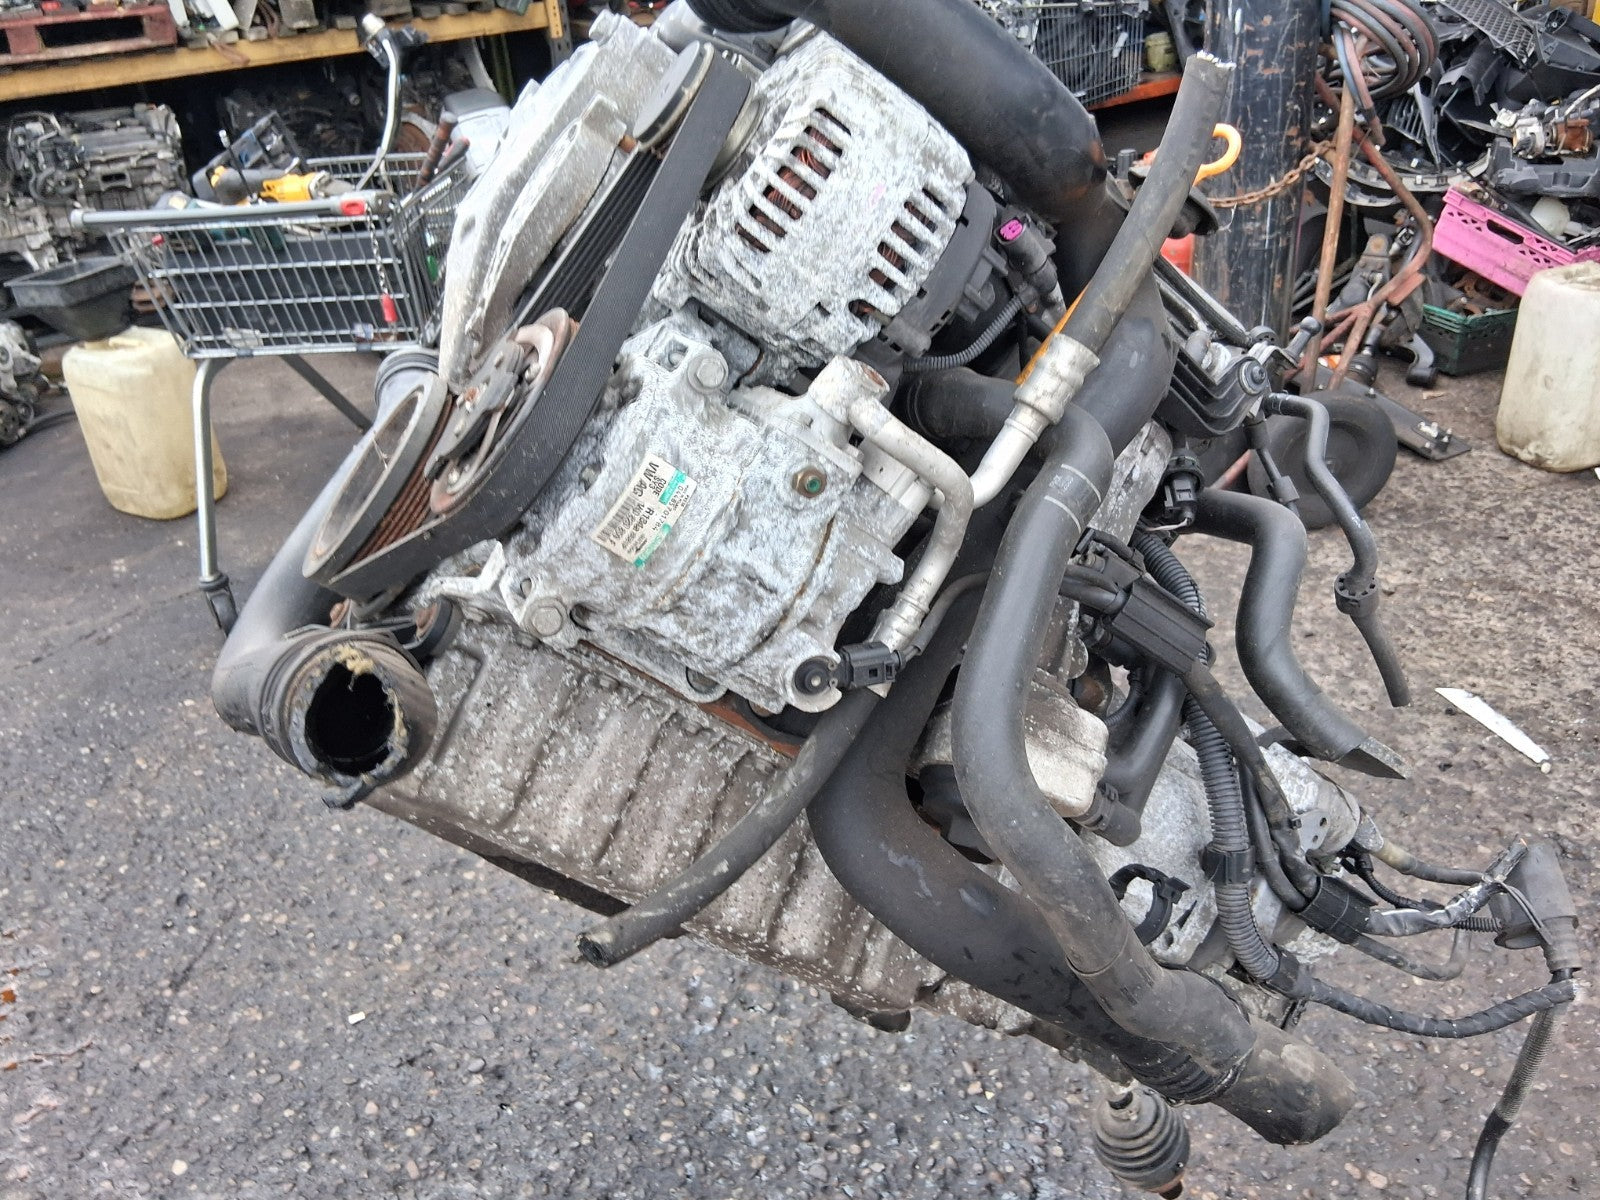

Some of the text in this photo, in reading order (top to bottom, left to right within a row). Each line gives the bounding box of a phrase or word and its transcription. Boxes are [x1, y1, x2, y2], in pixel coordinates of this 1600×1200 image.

[633, 462, 659, 497] VW AG
[649, 476, 660, 489] SY3
[653, 477, 667, 496] CODE
